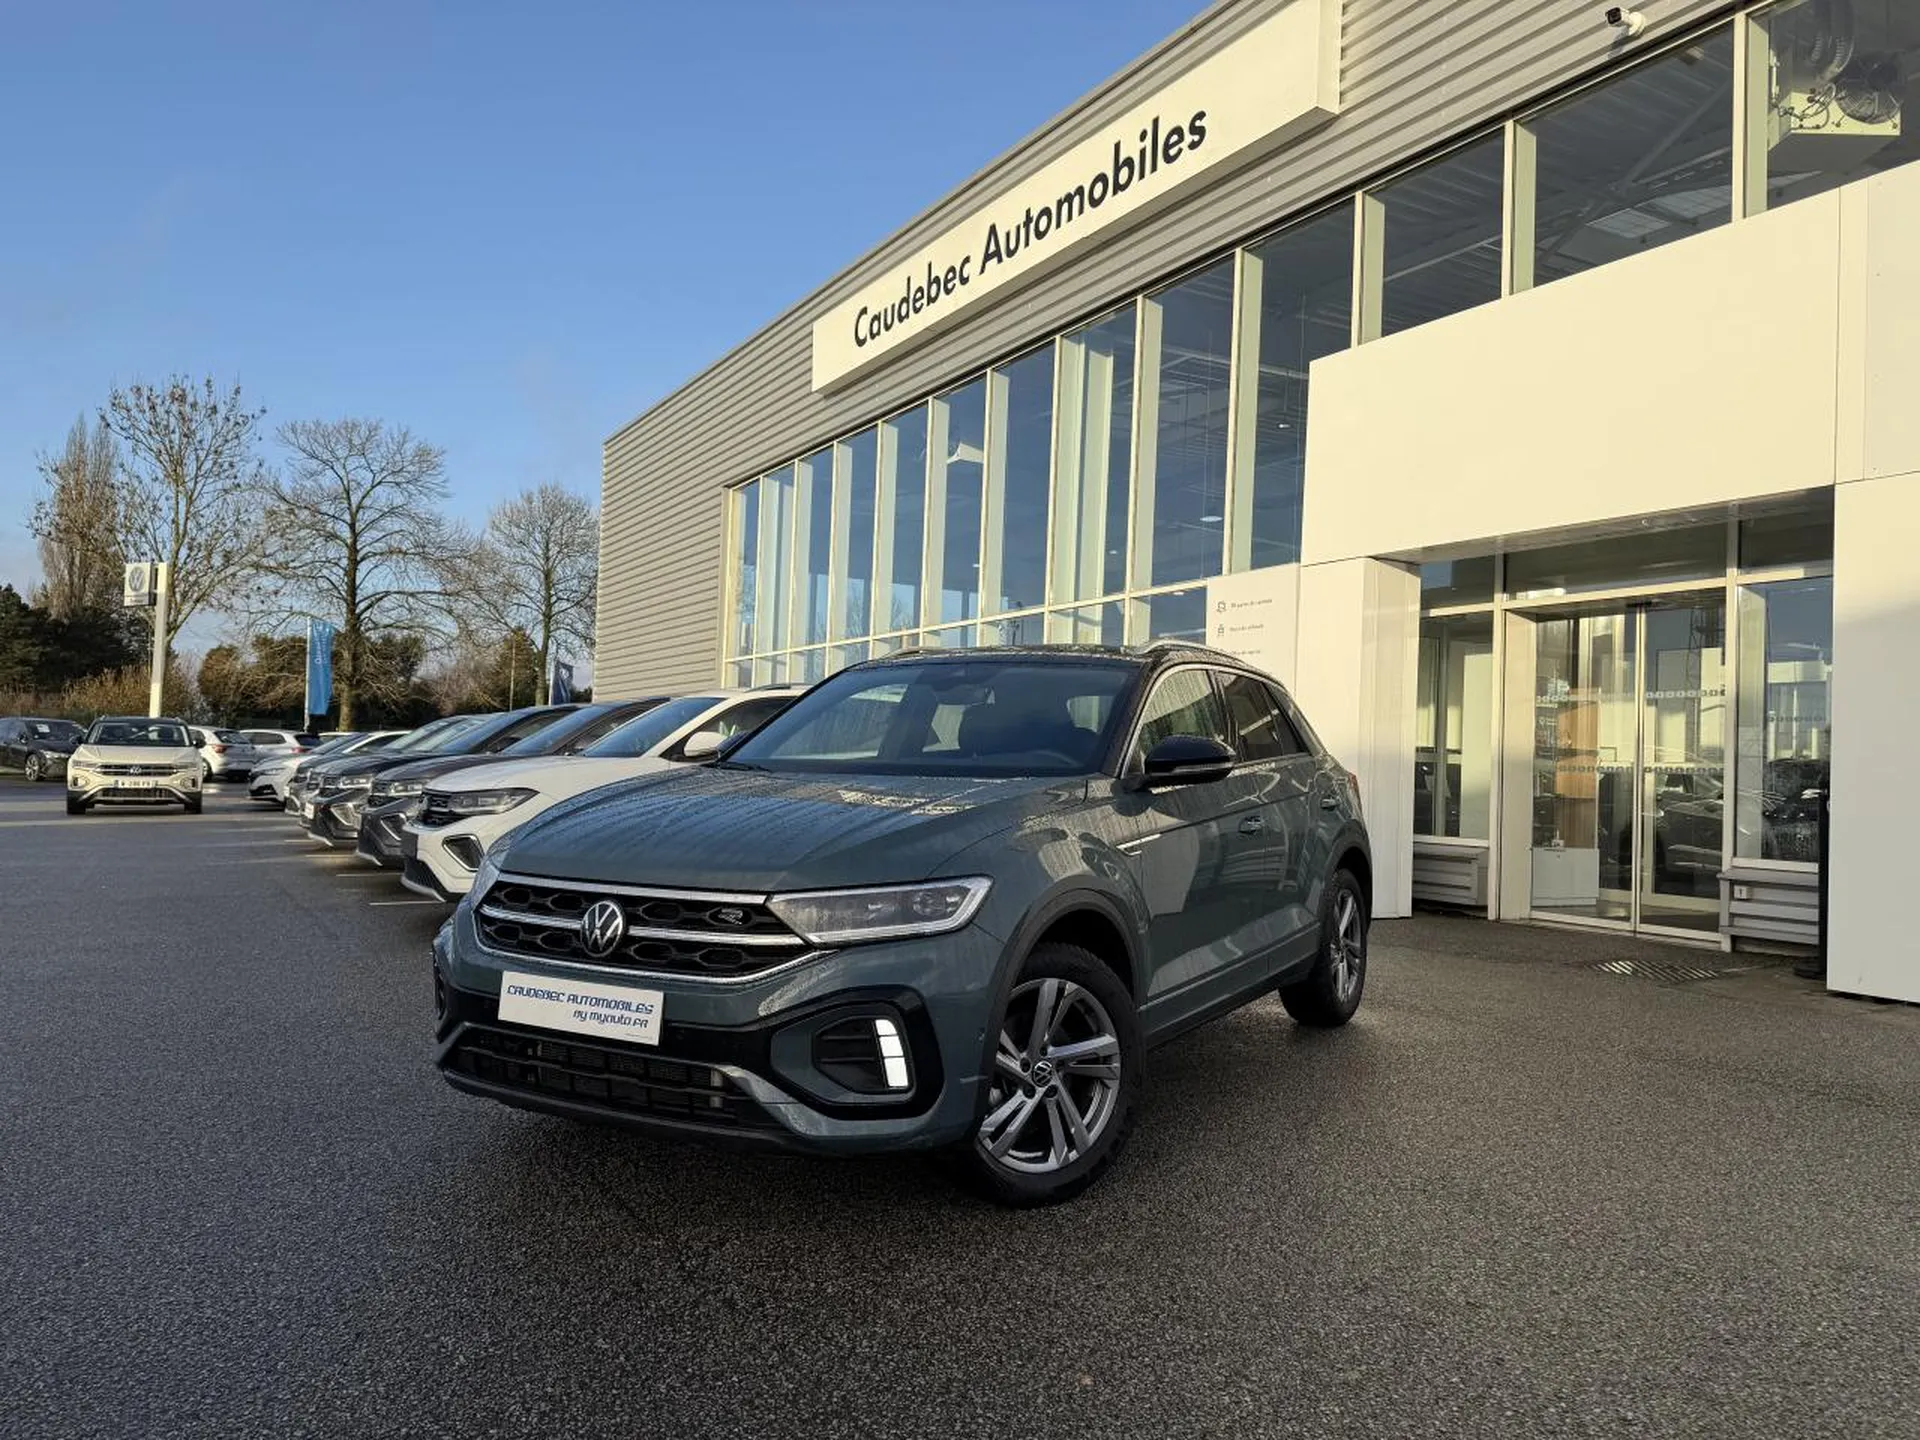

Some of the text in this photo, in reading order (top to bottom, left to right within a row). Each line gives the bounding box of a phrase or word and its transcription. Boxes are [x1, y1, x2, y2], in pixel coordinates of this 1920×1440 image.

[854, 111, 1207, 348] Caudebec Automobiles
[507, 984, 654, 1015] CAUDEBEC AUTOMOBILES
